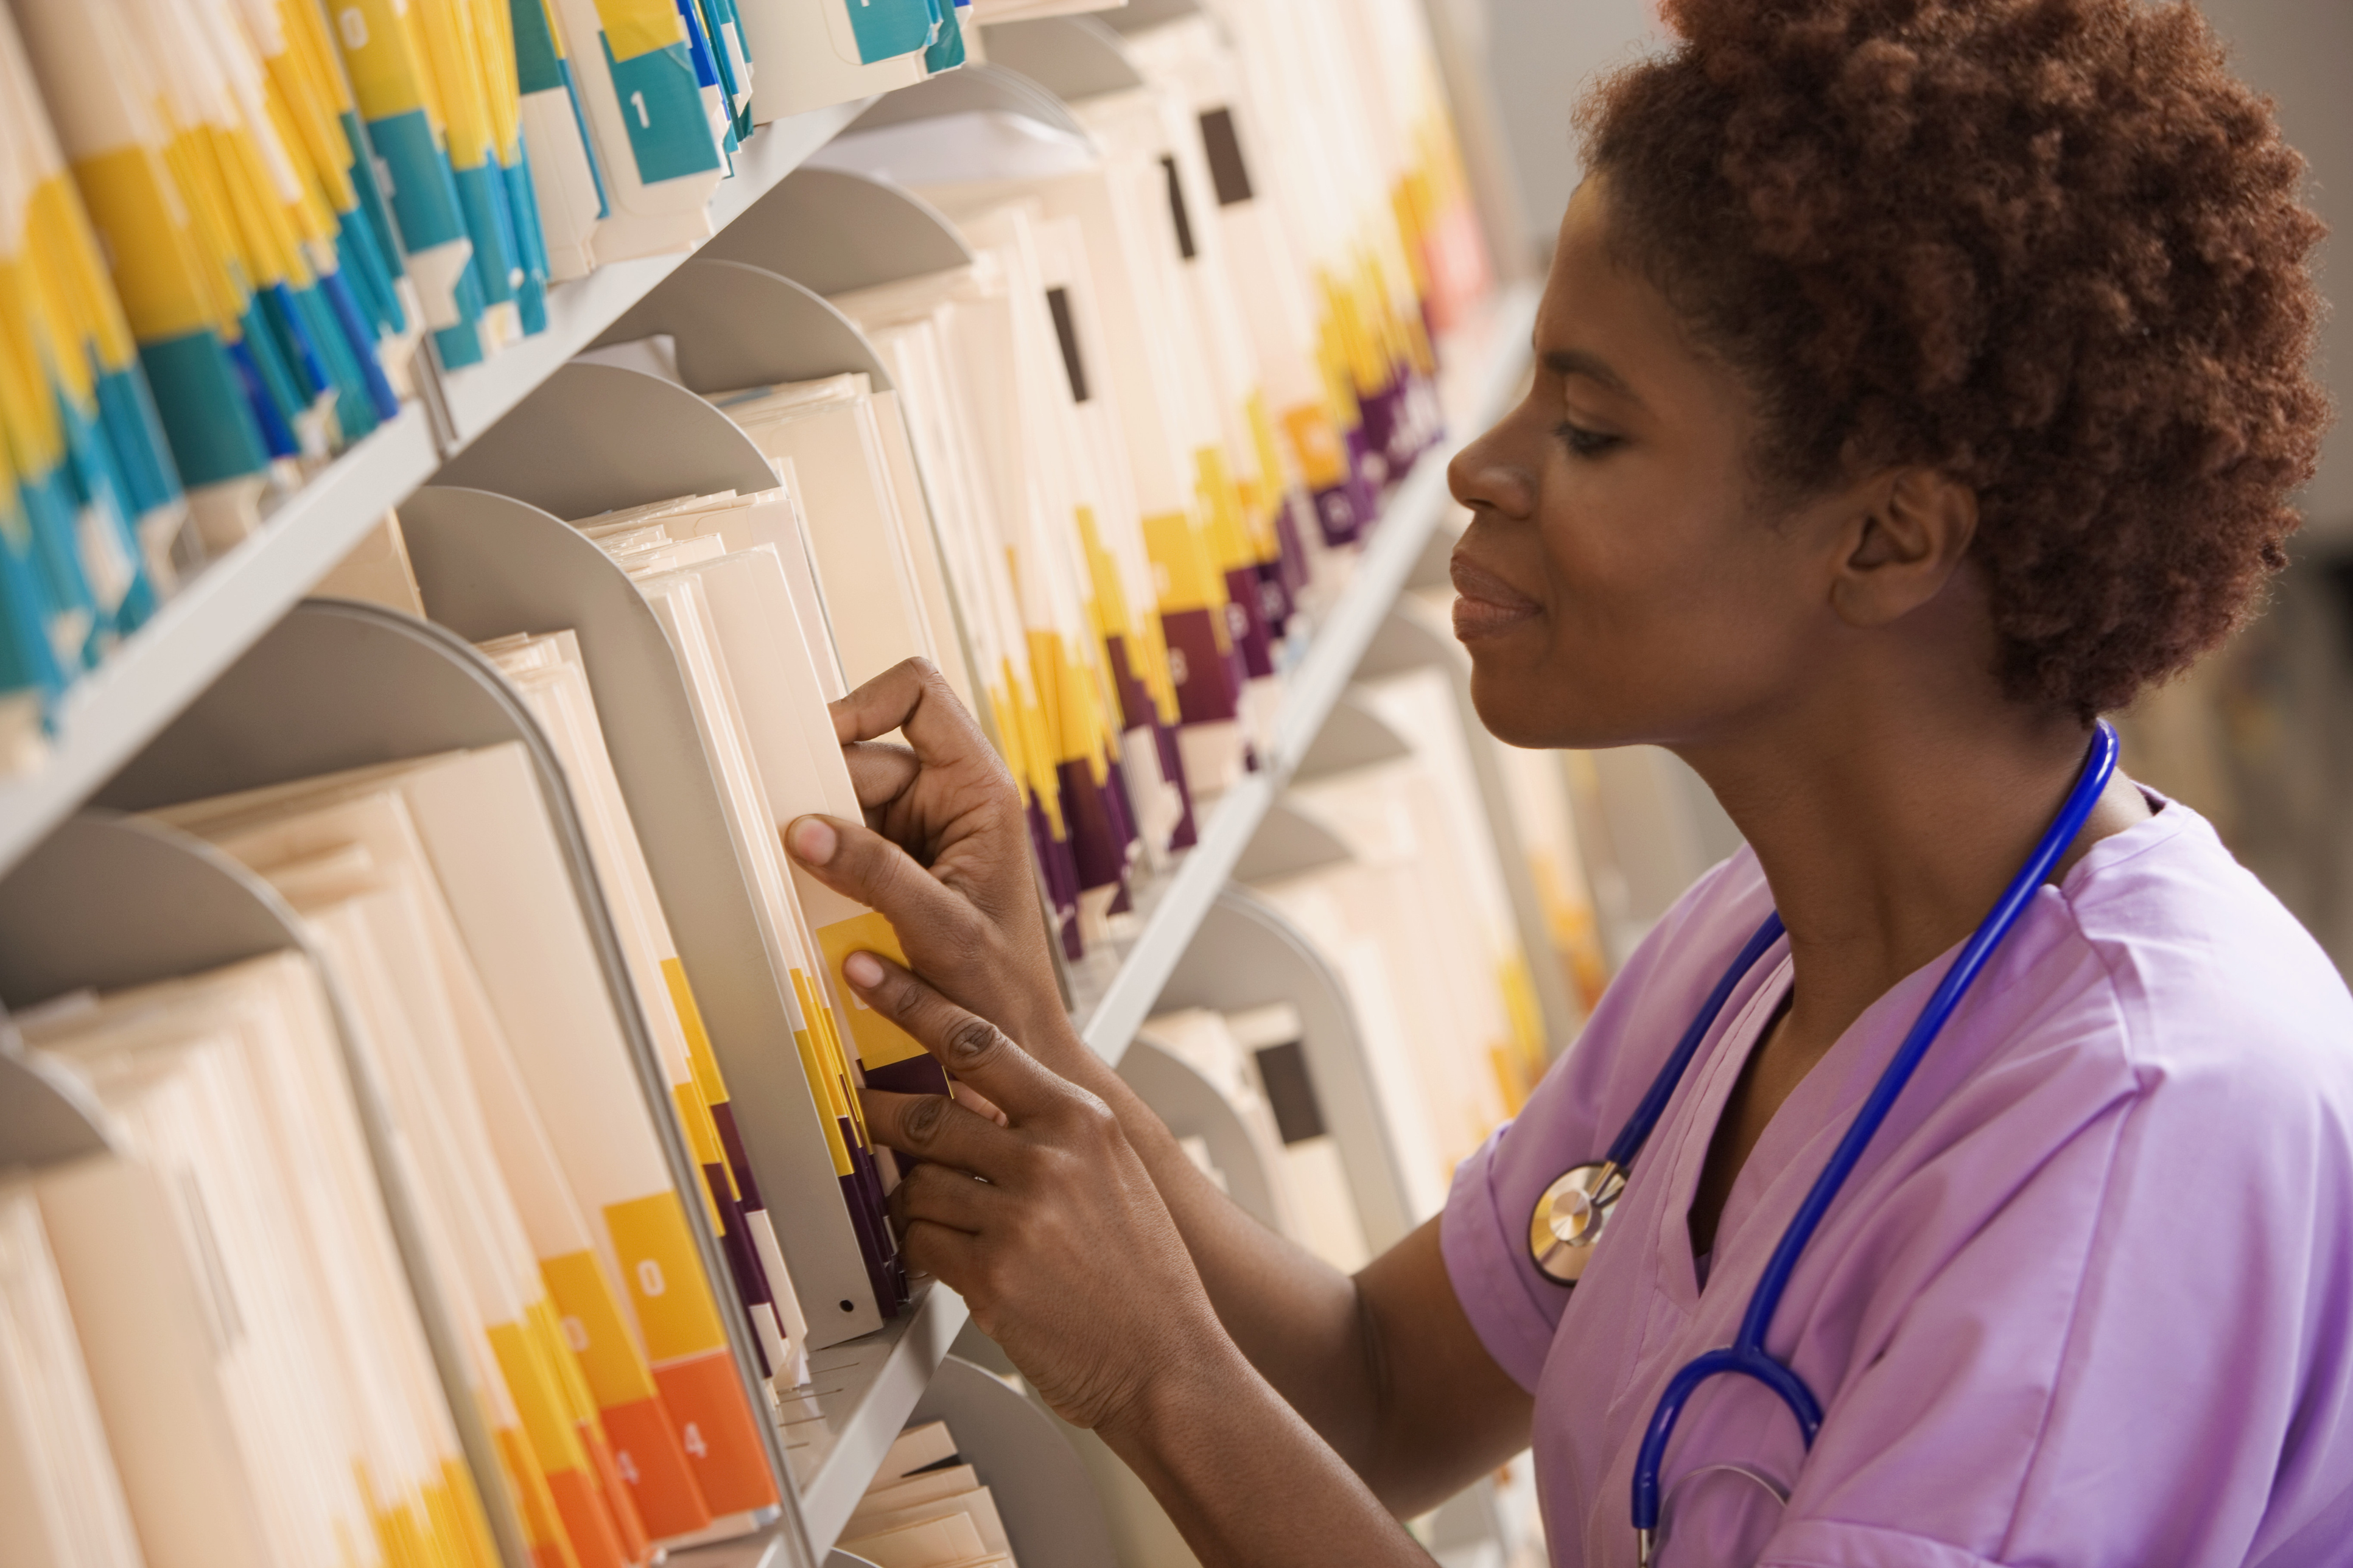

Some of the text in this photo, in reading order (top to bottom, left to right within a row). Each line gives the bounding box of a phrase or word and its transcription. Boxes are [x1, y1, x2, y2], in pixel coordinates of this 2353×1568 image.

[630, 90, 650, 128] 1
[637, 1259, 665, 1297] 0
[685, 1421, 707, 1458] 4
